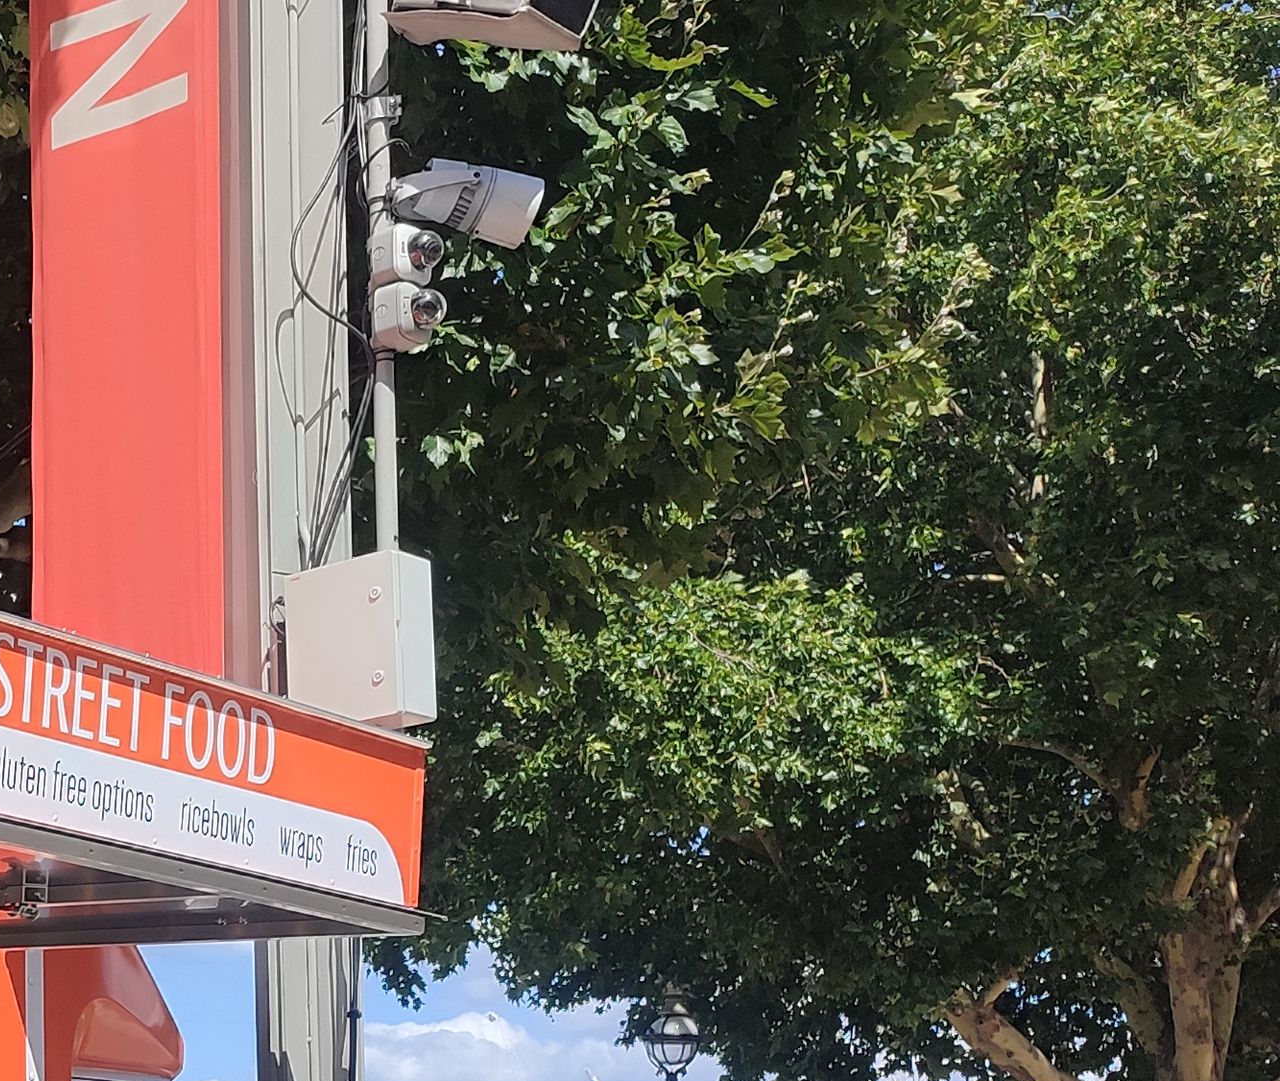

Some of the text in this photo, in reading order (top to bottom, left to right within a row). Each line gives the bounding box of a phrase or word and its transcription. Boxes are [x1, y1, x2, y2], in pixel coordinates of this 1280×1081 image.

[161, 683, 276, 785] FOOD
[52, 760, 88, 807] free
[91, 780, 154, 824] options
[179, 798, 256, 848] ricebowls
[279, 824, 324, 867] wraps
[345, 835, 378, 877] fries
